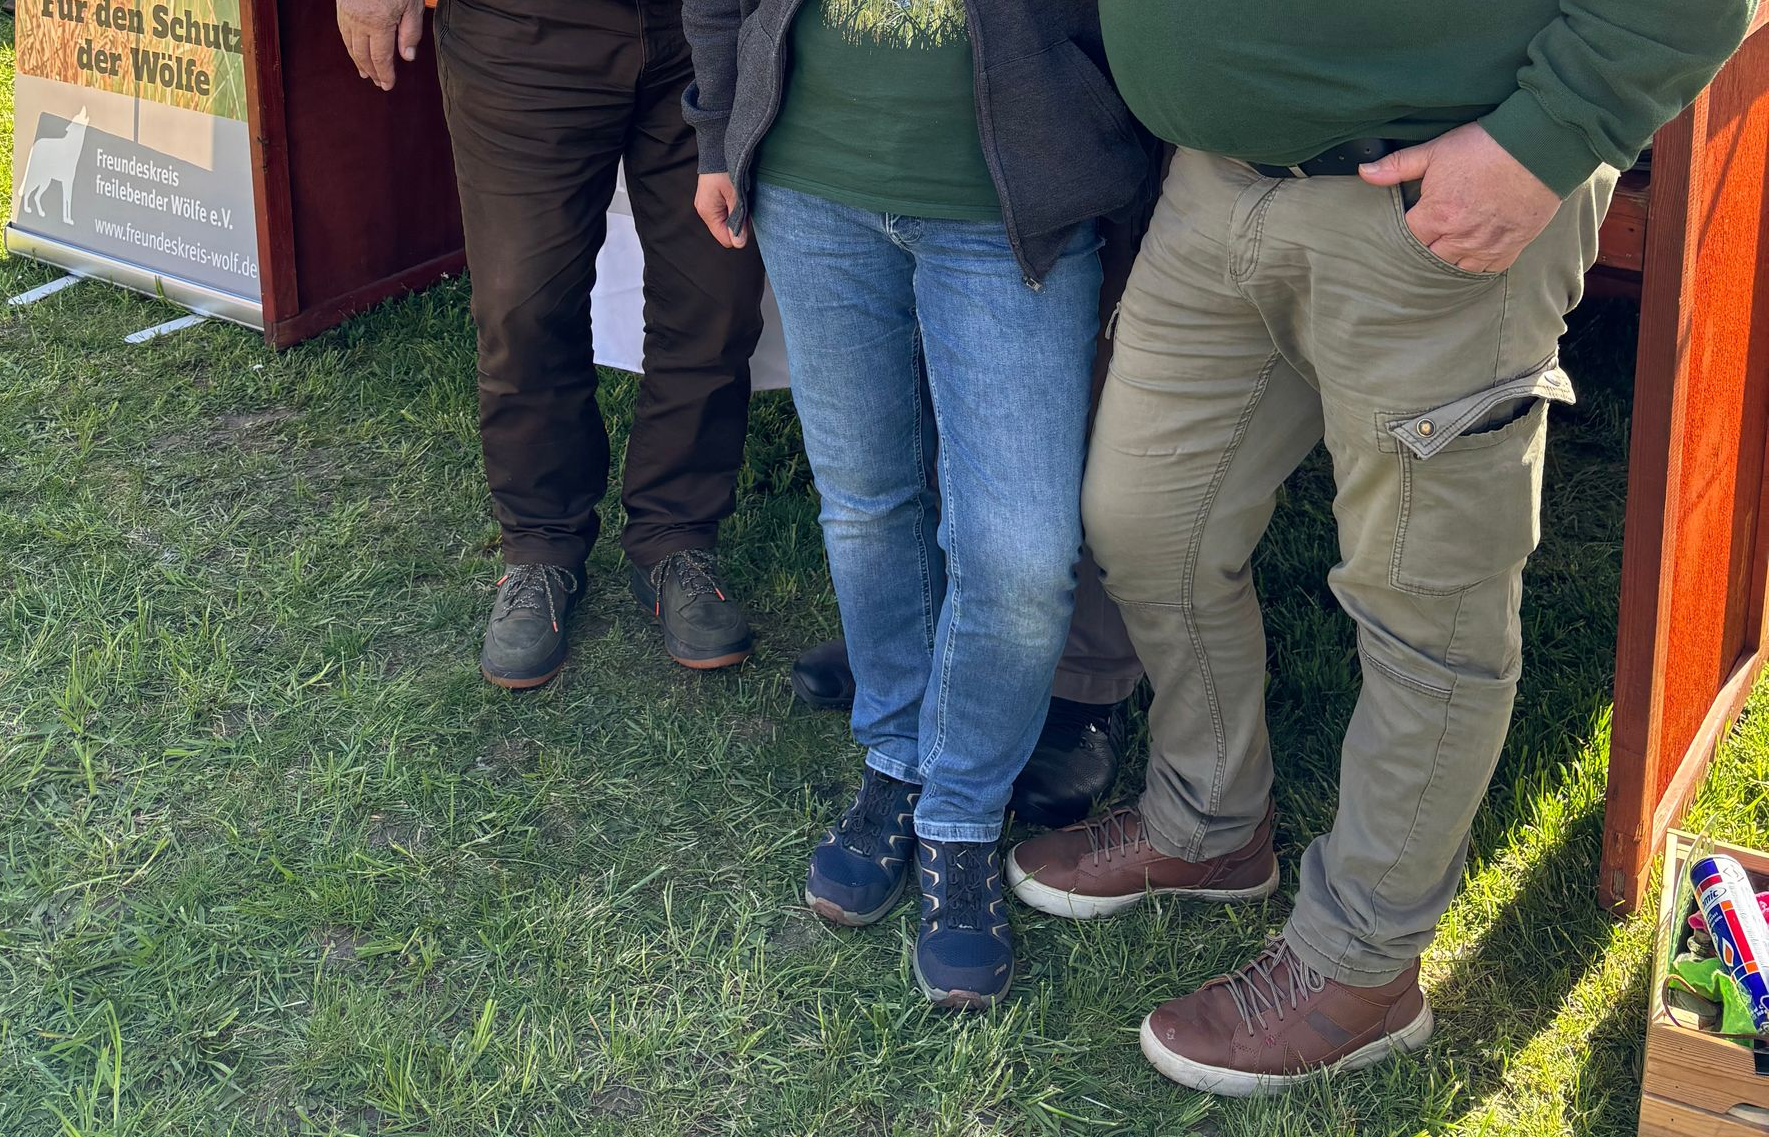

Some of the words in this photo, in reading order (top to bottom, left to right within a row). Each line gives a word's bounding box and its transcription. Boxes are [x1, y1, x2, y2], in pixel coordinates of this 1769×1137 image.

[77, 38, 122, 77] der
[130, 47, 210, 96] Wölfe
[96, 148, 179, 187] Freundeskreis
[96, 174, 169, 212] freilebender
[170, 194, 207, 223] Wölfe
[210, 207, 233, 230] e.V.
[94, 218, 258, 279] www.freundeskreis-wolf.de
